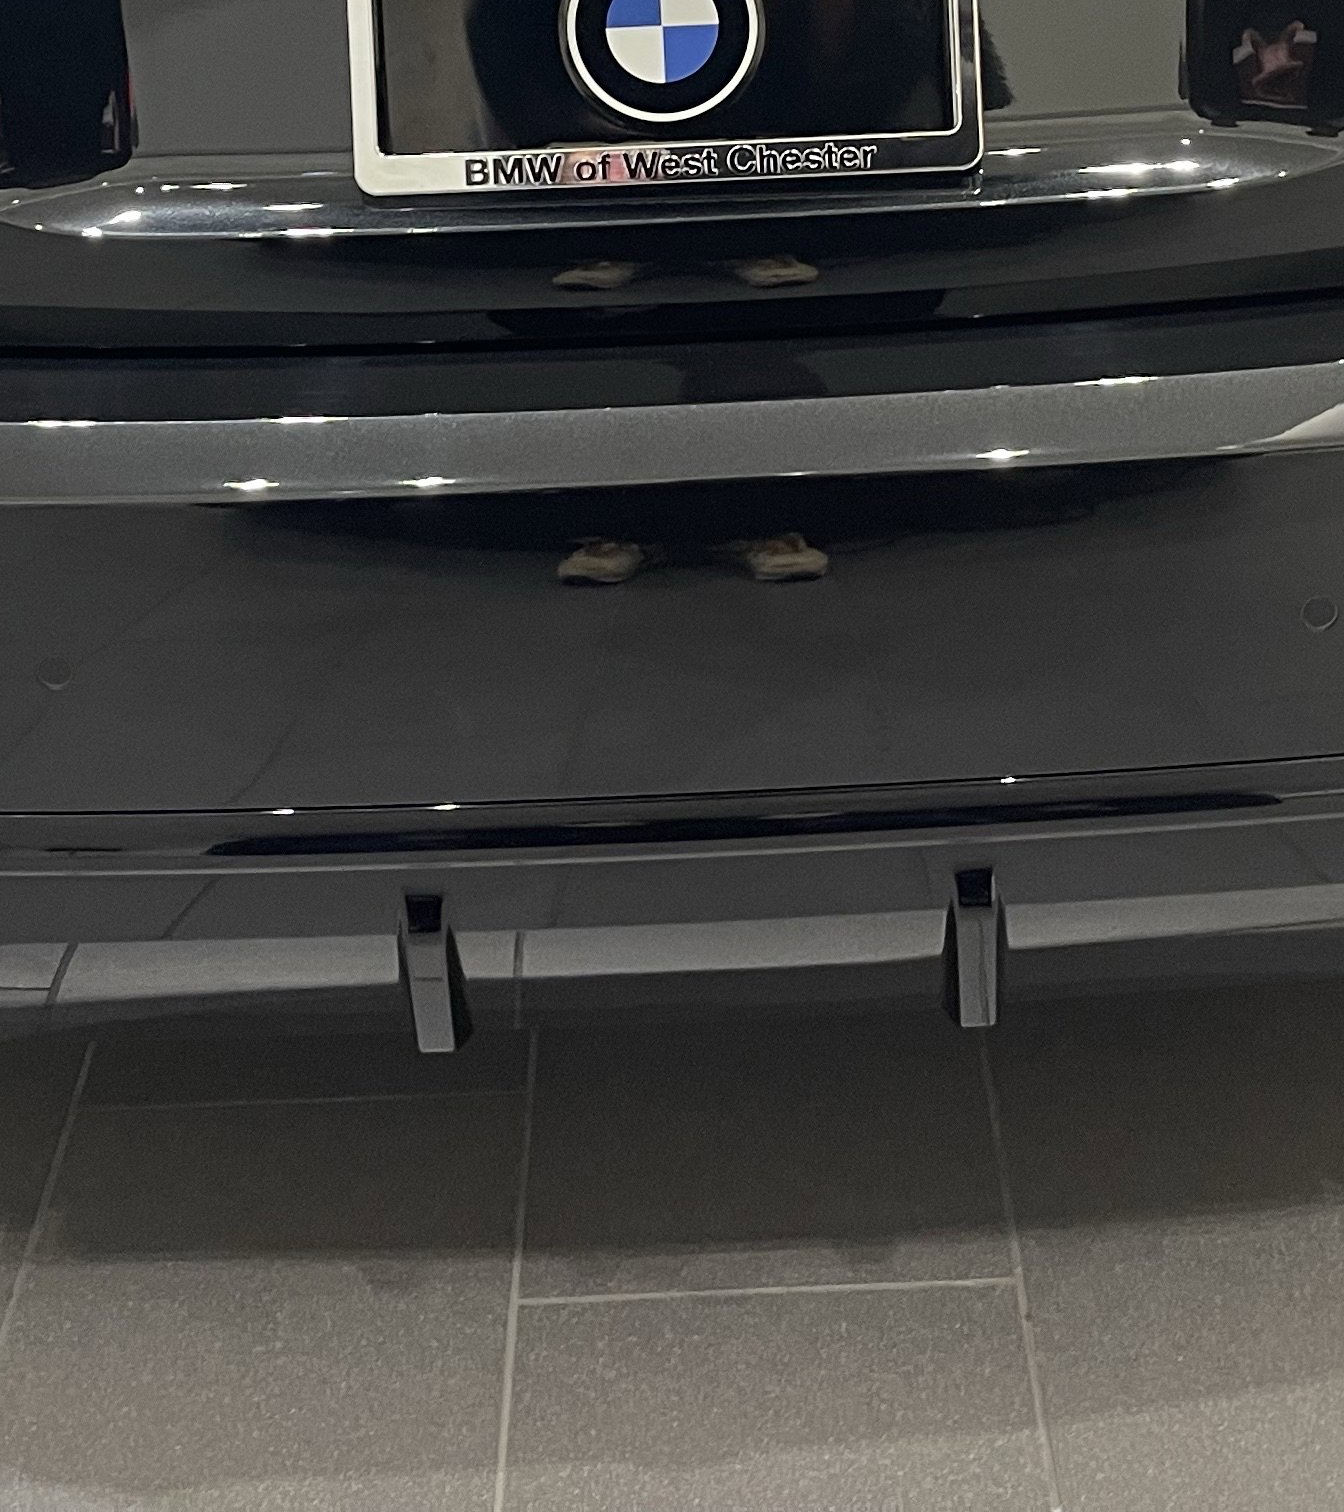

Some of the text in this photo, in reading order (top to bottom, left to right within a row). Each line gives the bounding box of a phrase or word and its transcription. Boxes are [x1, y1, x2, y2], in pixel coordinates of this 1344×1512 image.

[464, 142, 878, 186] BMW of West Chester
